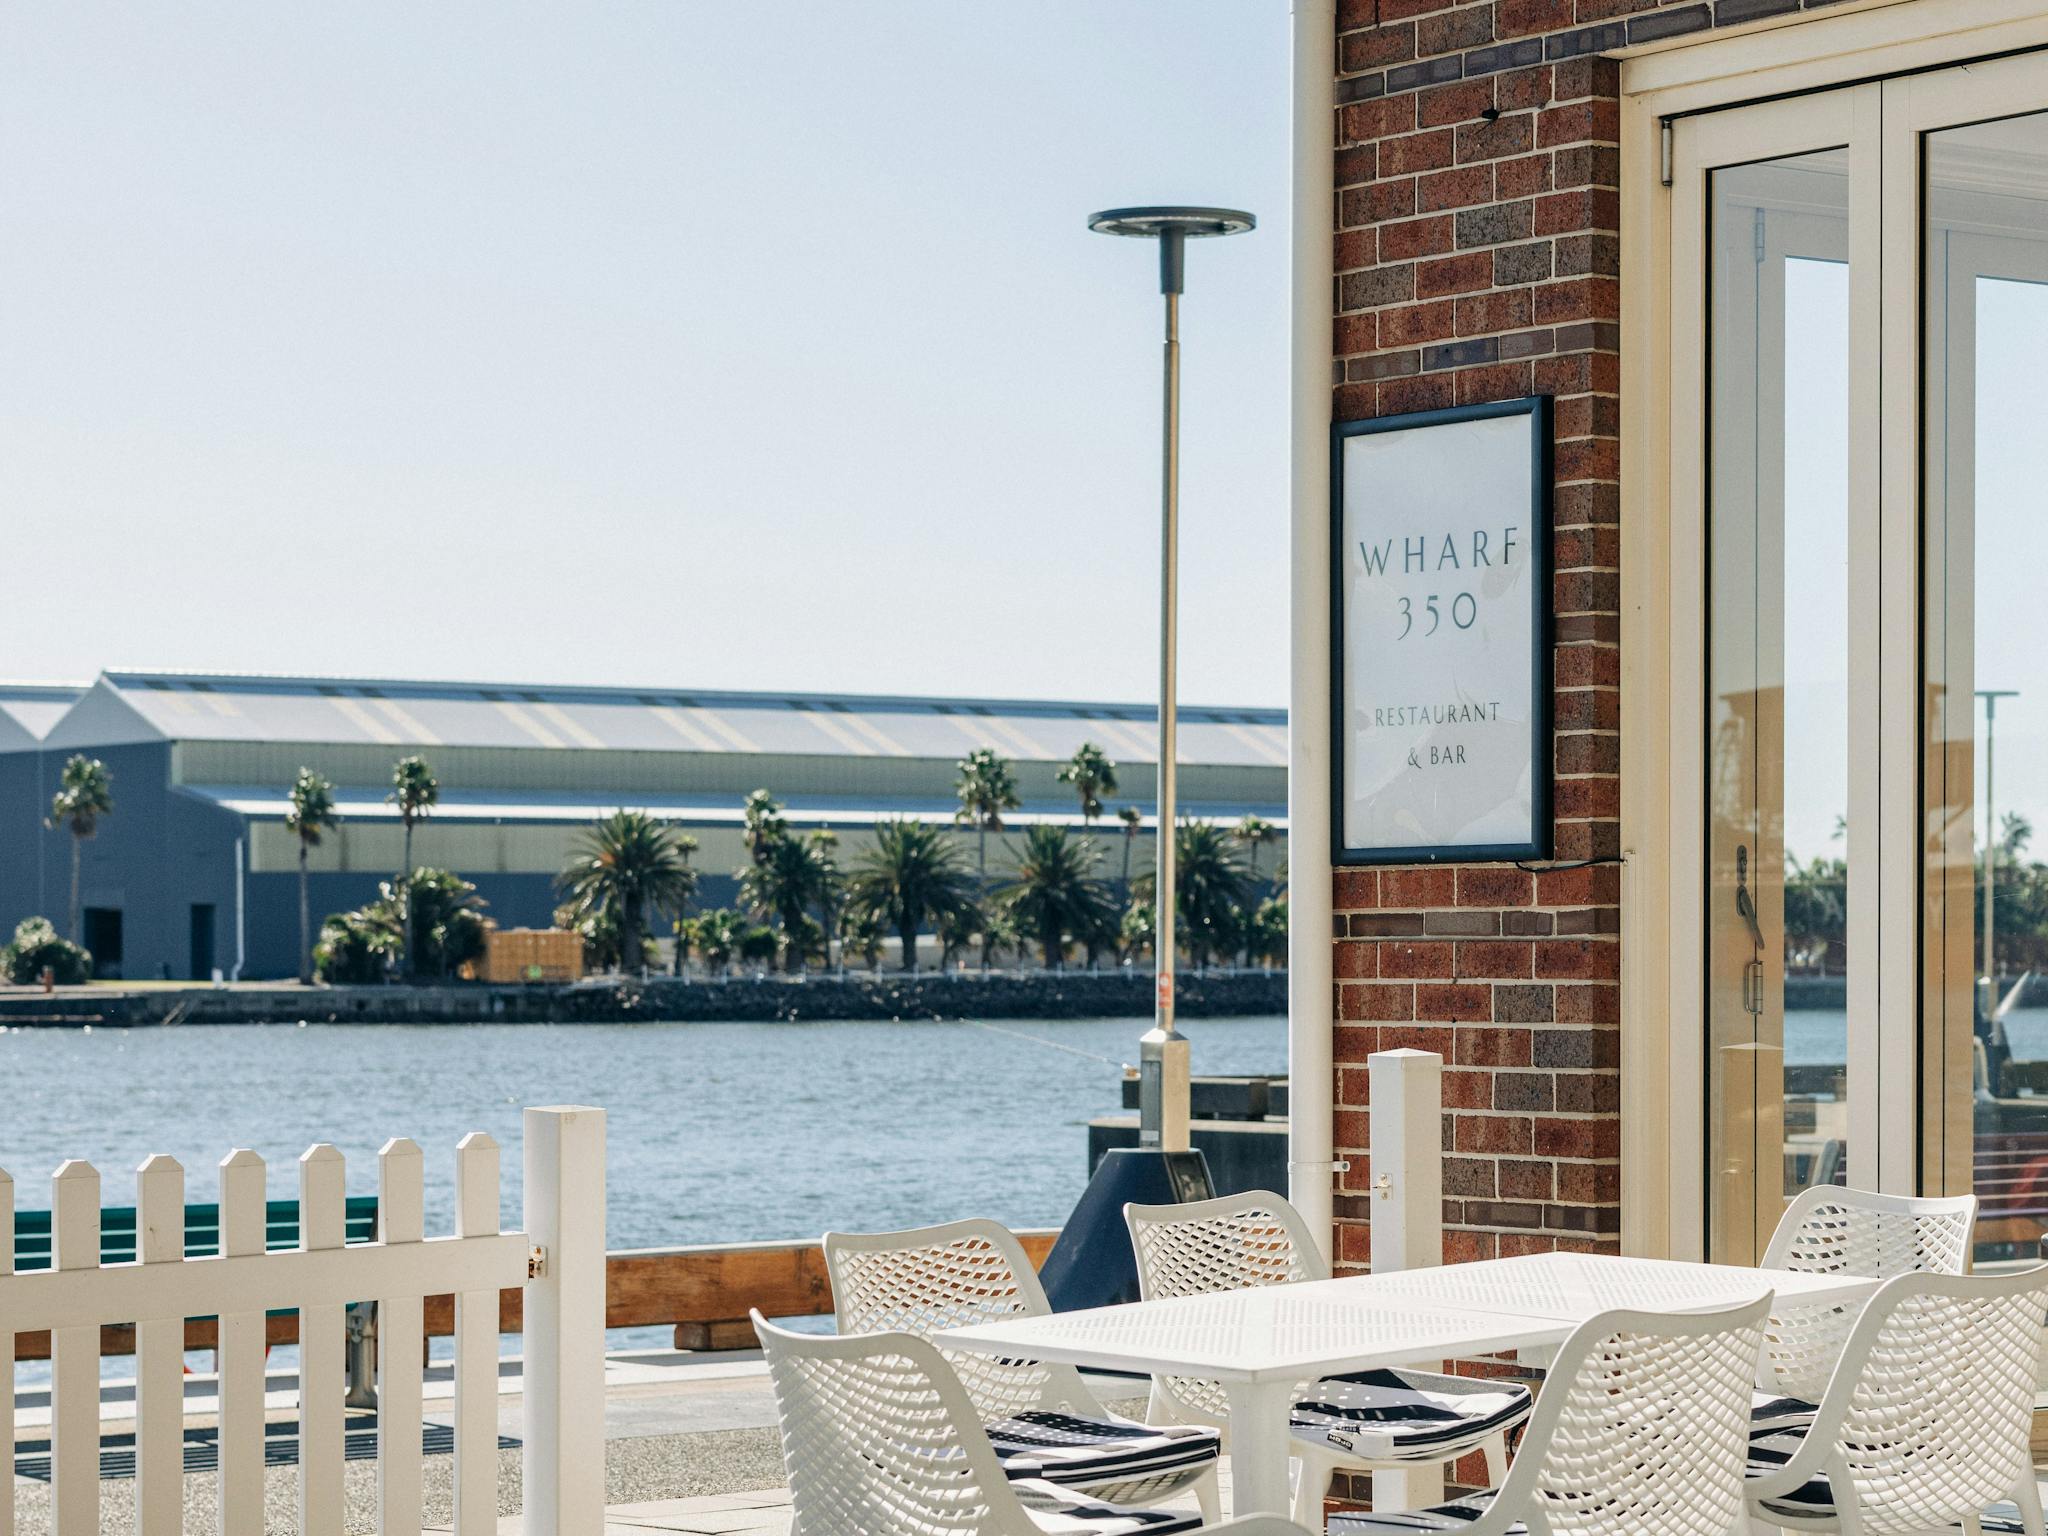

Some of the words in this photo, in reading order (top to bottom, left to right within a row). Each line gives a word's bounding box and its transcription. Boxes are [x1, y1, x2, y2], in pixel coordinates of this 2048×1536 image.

[1360, 527, 1518, 577] WHARF
[1397, 592, 1477, 641] 350
[1375, 702, 1500, 727] RESTAURANT
[1407, 749, 1422, 769] &
[1430, 745, 1467, 765] BAR
